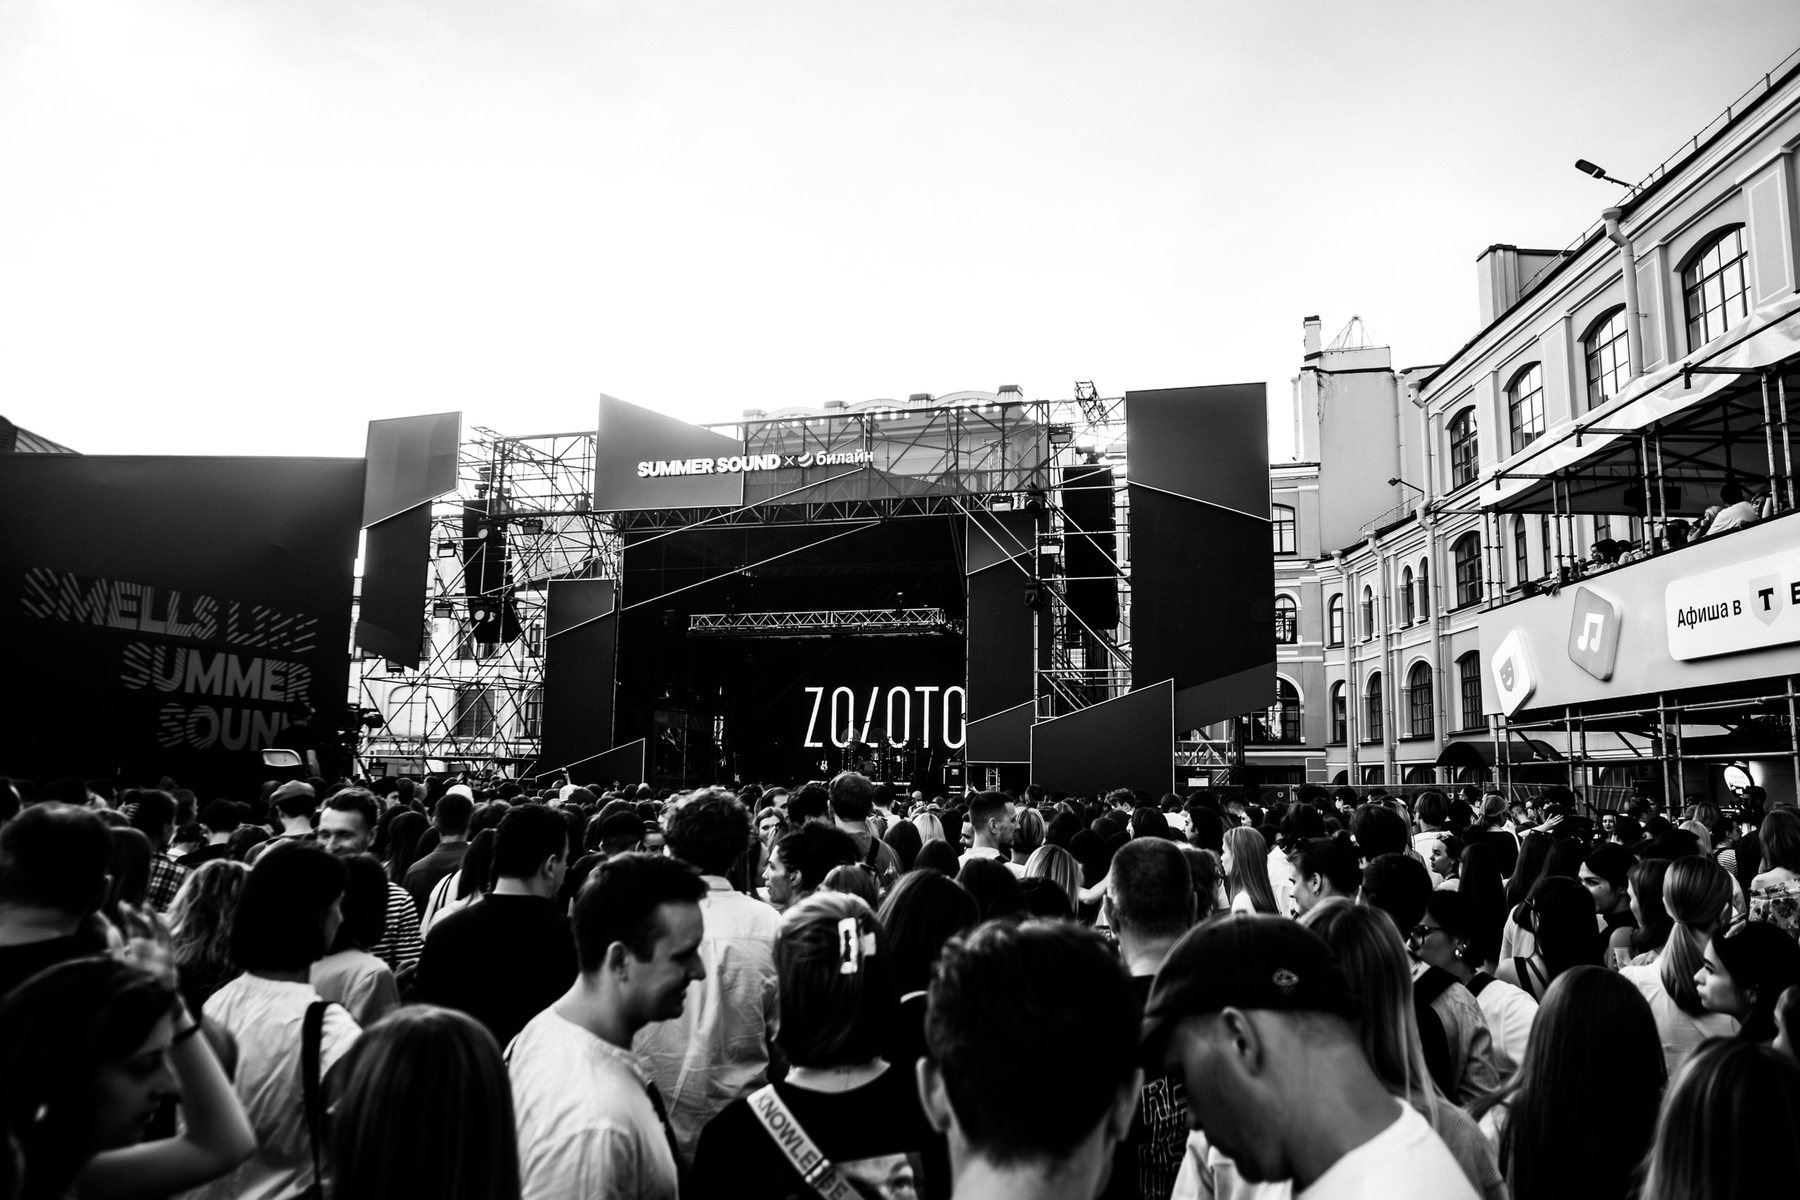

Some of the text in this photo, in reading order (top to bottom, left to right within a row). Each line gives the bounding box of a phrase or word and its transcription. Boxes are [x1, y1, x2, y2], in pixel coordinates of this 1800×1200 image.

[637, 458, 715, 478] SUMMER
[716, 453, 782, 474] SOUND
[816, 448, 875, 467] билайн
[21, 567, 219, 640] SMELLS
[1677, 602, 1729, 629] Афиша
[1732, 599, 1742, 616] в
[120, 641, 312, 702] SUMMER
[156, 702, 291, 751] SOUN
